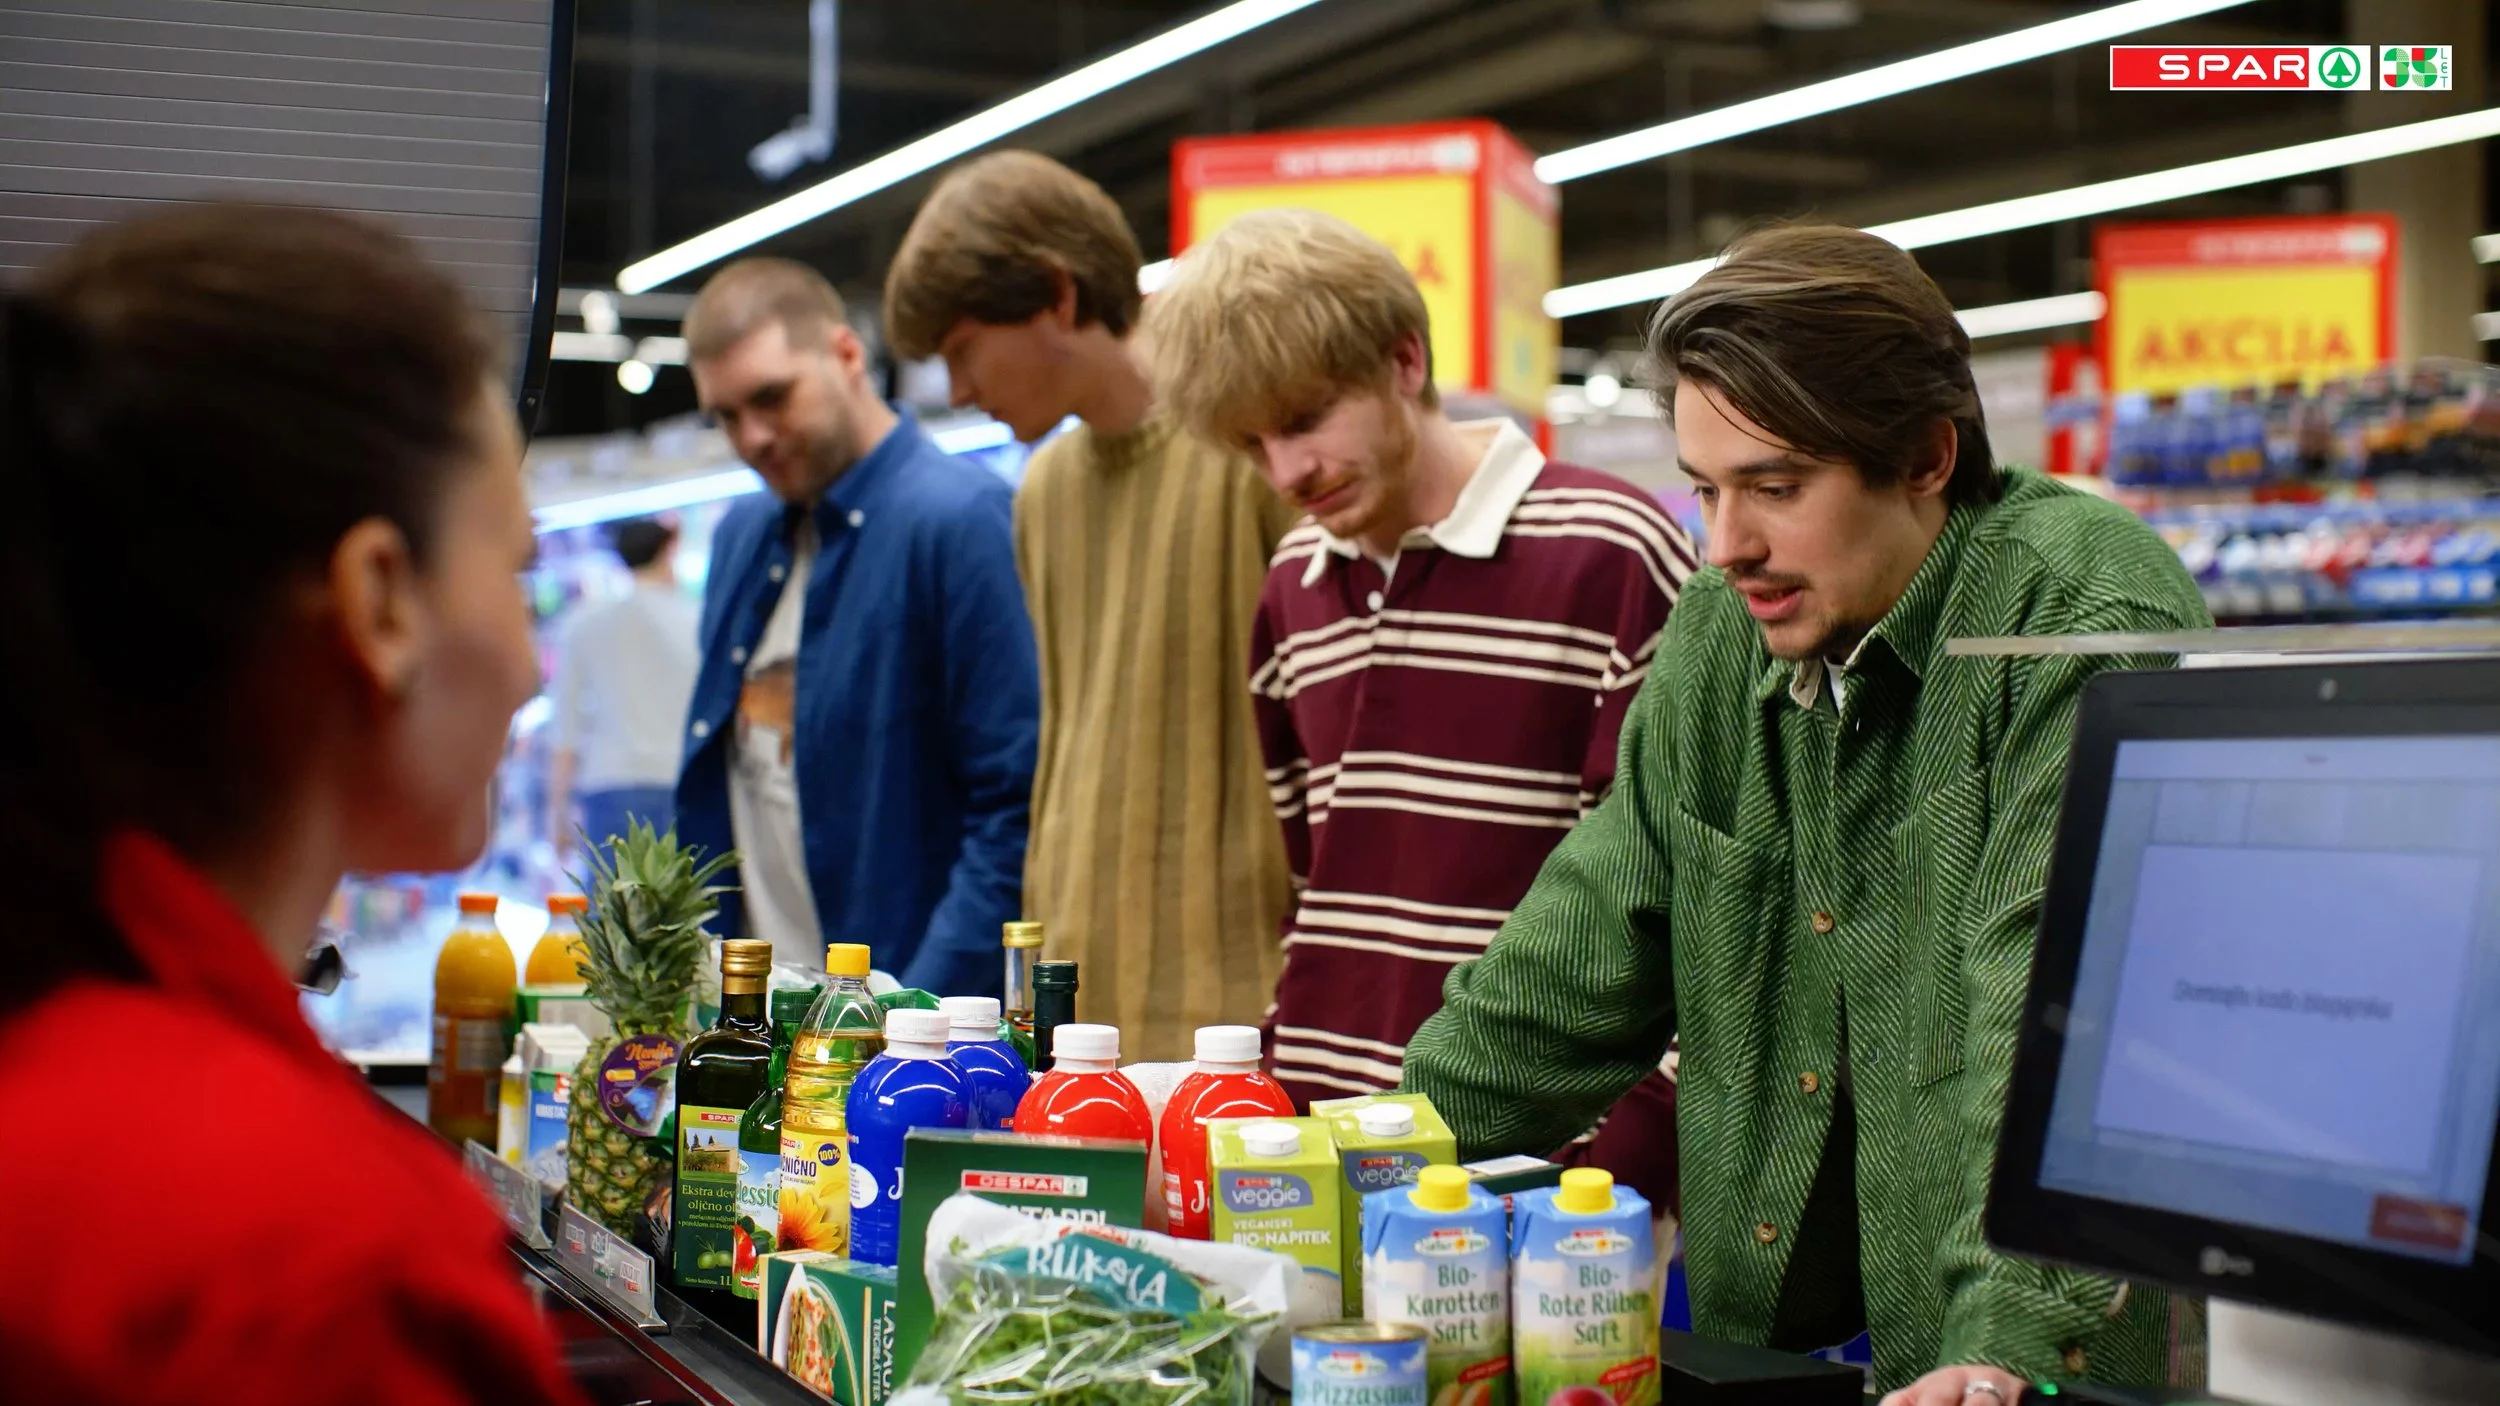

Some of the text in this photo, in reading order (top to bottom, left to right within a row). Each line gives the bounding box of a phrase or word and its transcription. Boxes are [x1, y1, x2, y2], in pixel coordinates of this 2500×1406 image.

[819, 1149, 840, 1161] 100%
[682, 1184, 713, 1196] Ekstra
[979, 1173, 1063, 1193] DESPAR
[688, 1200, 722, 1212] oljčno
[1232, 1184, 1301, 1207] veggie
[1438, 1264, 1477, 1288] Bio-
[1579, 1262, 1620, 1288] Bio-
[1539, 1293, 1586, 1316] Rote
[1433, 1317, 1479, 1346] Saft
[1574, 1320, 1621, 1347] Saft
